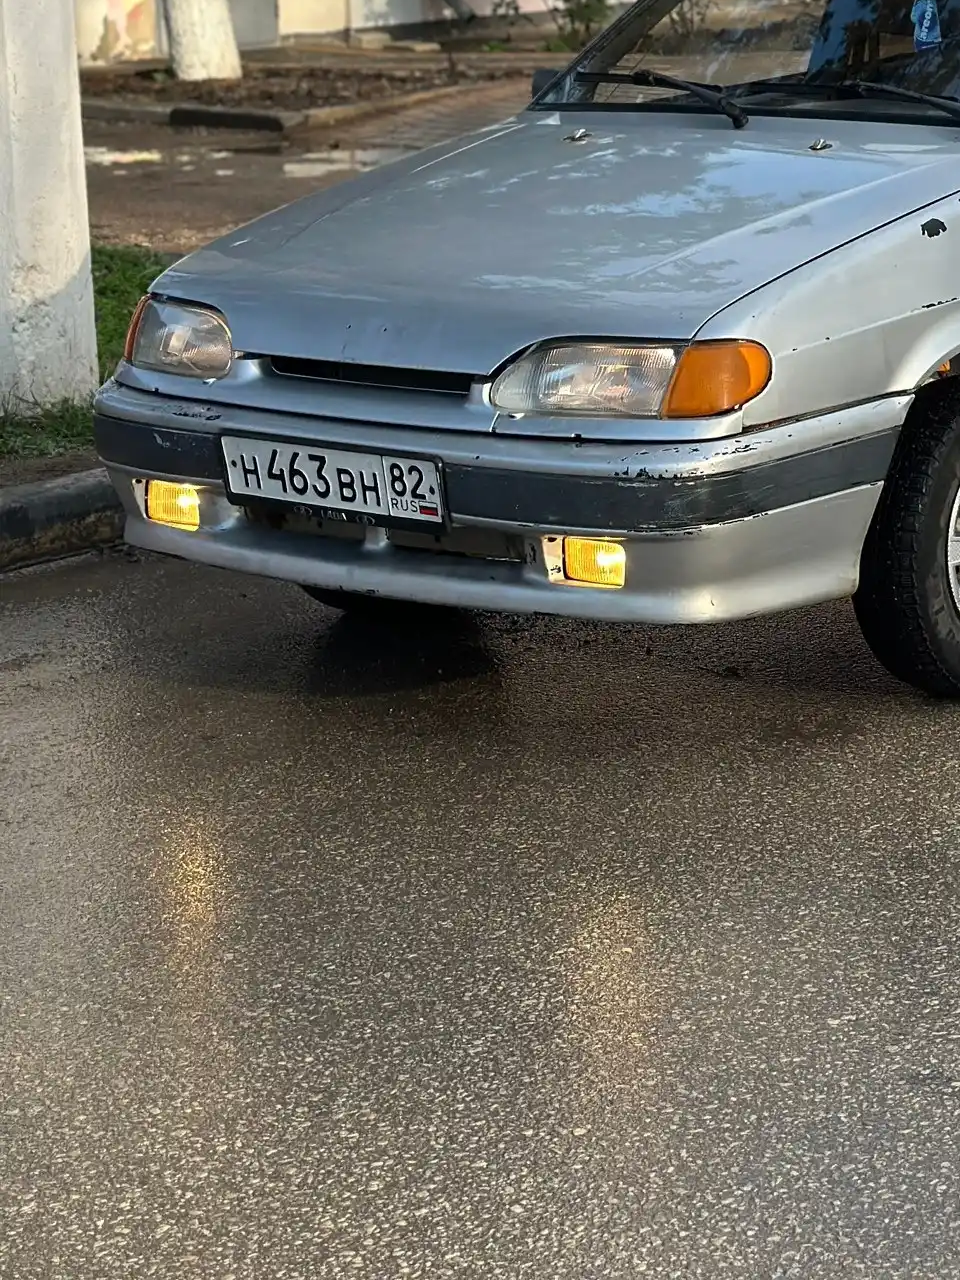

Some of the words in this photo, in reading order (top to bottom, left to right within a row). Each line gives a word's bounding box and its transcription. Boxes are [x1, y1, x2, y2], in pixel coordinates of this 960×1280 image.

[920, 0, 935, 40] areon
[389, 462, 427, 500] 82
[391, 497, 419, 513] RUS
